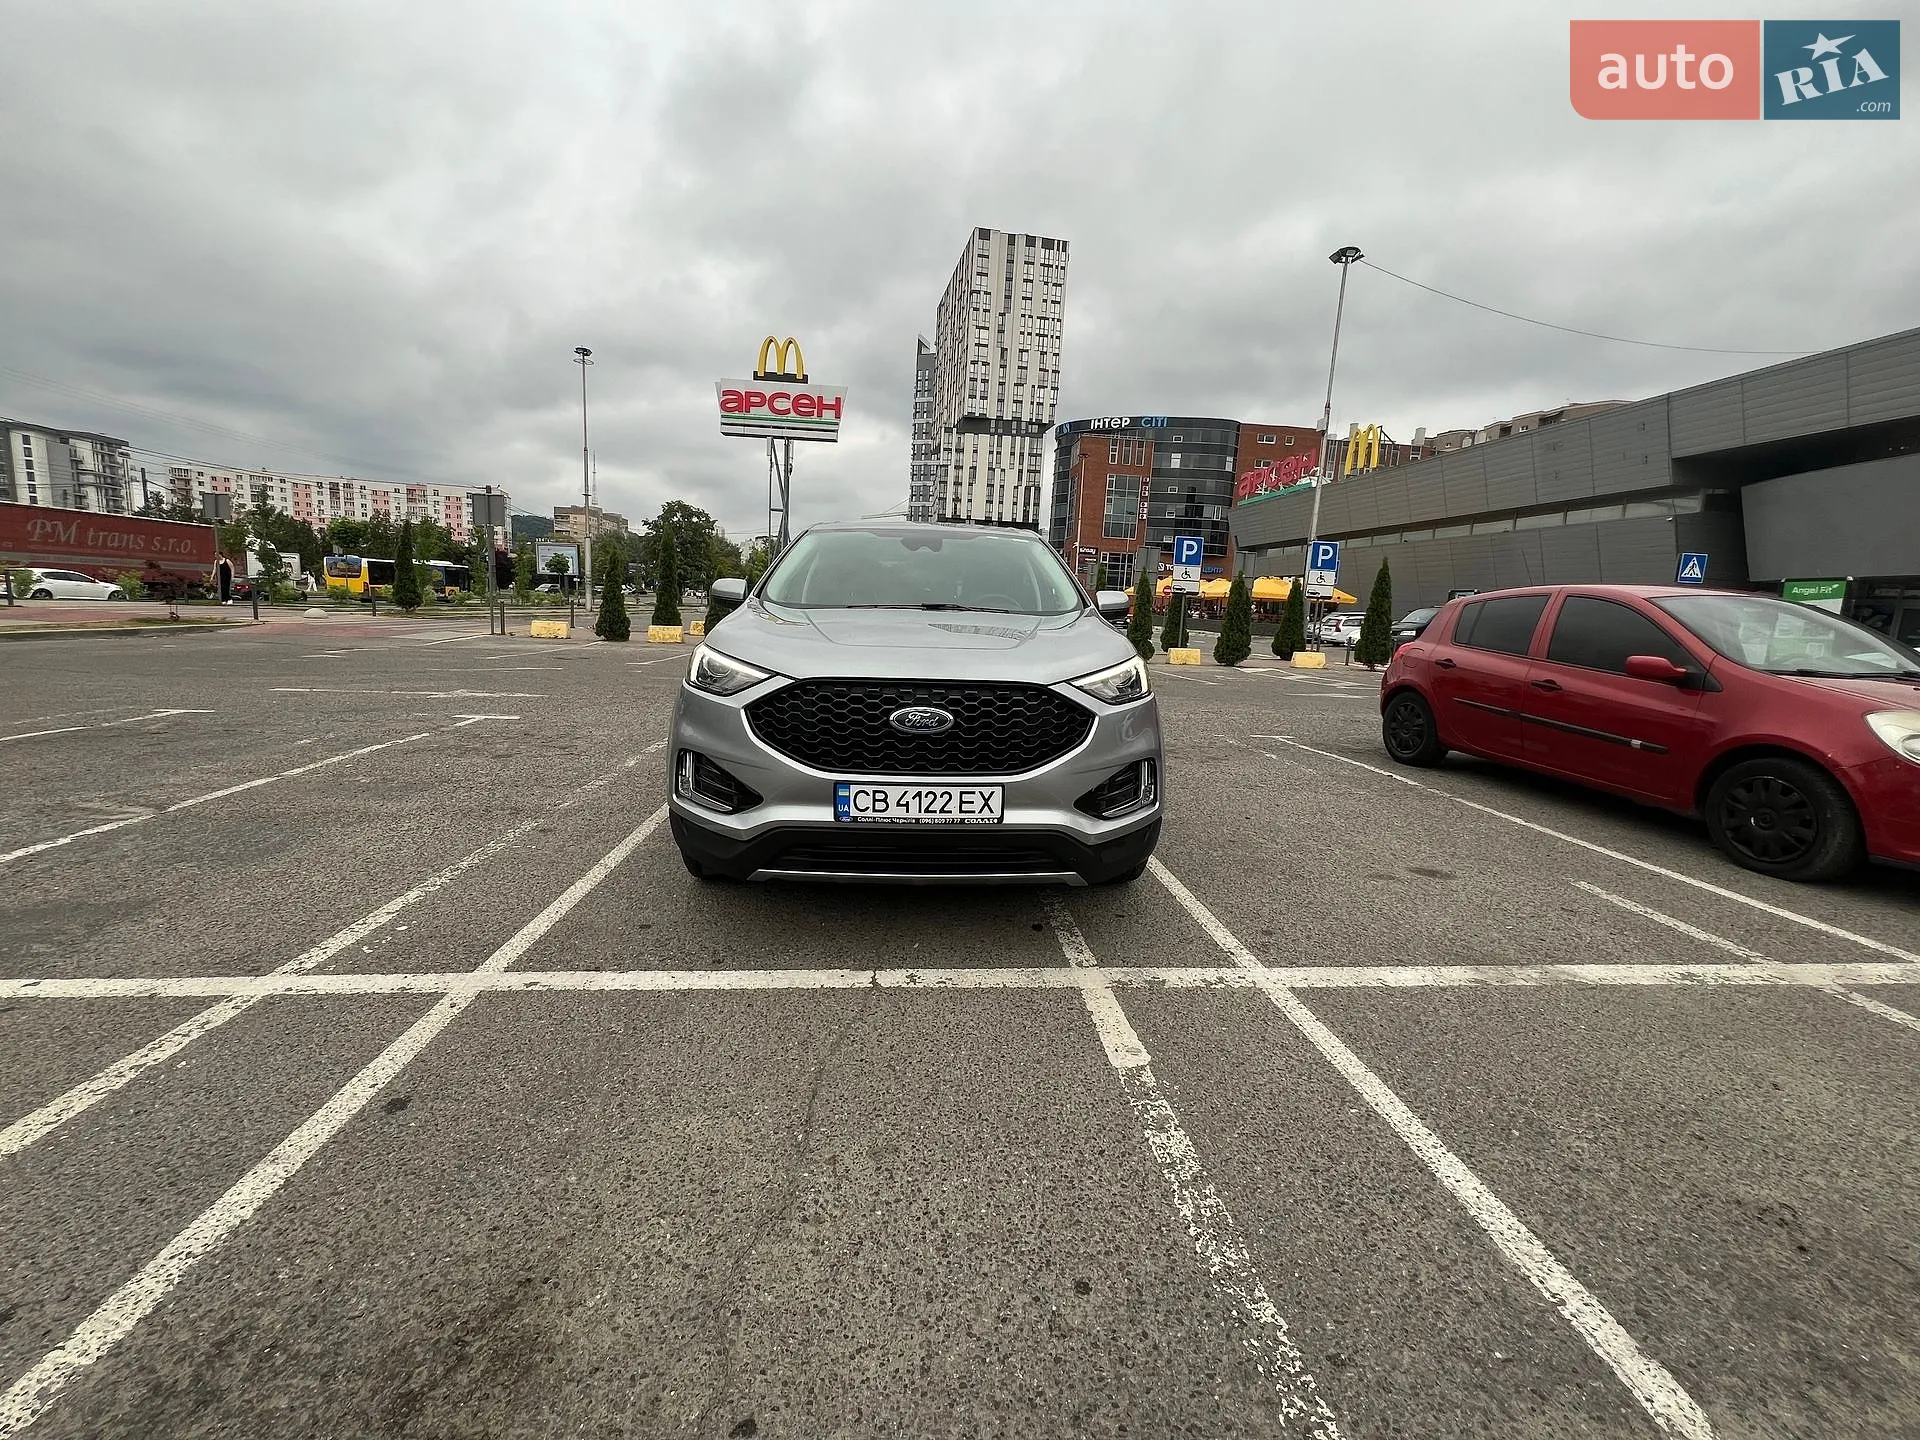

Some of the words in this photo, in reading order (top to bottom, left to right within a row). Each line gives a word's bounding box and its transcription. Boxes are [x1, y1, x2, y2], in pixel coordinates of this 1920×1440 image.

[27, 519, 81, 545] PM
[87, 528, 145, 550] trans
[1792, 586, 1818, 595] Angel
[1820, 586, 1832, 594] Fit
[904, 711, 939, 727] Ford
[838, 804, 849, 812] UA
[853, 789, 890, 813] CB
[895, 790, 953, 814] 4122
[958, 791, 996, 814] EX
